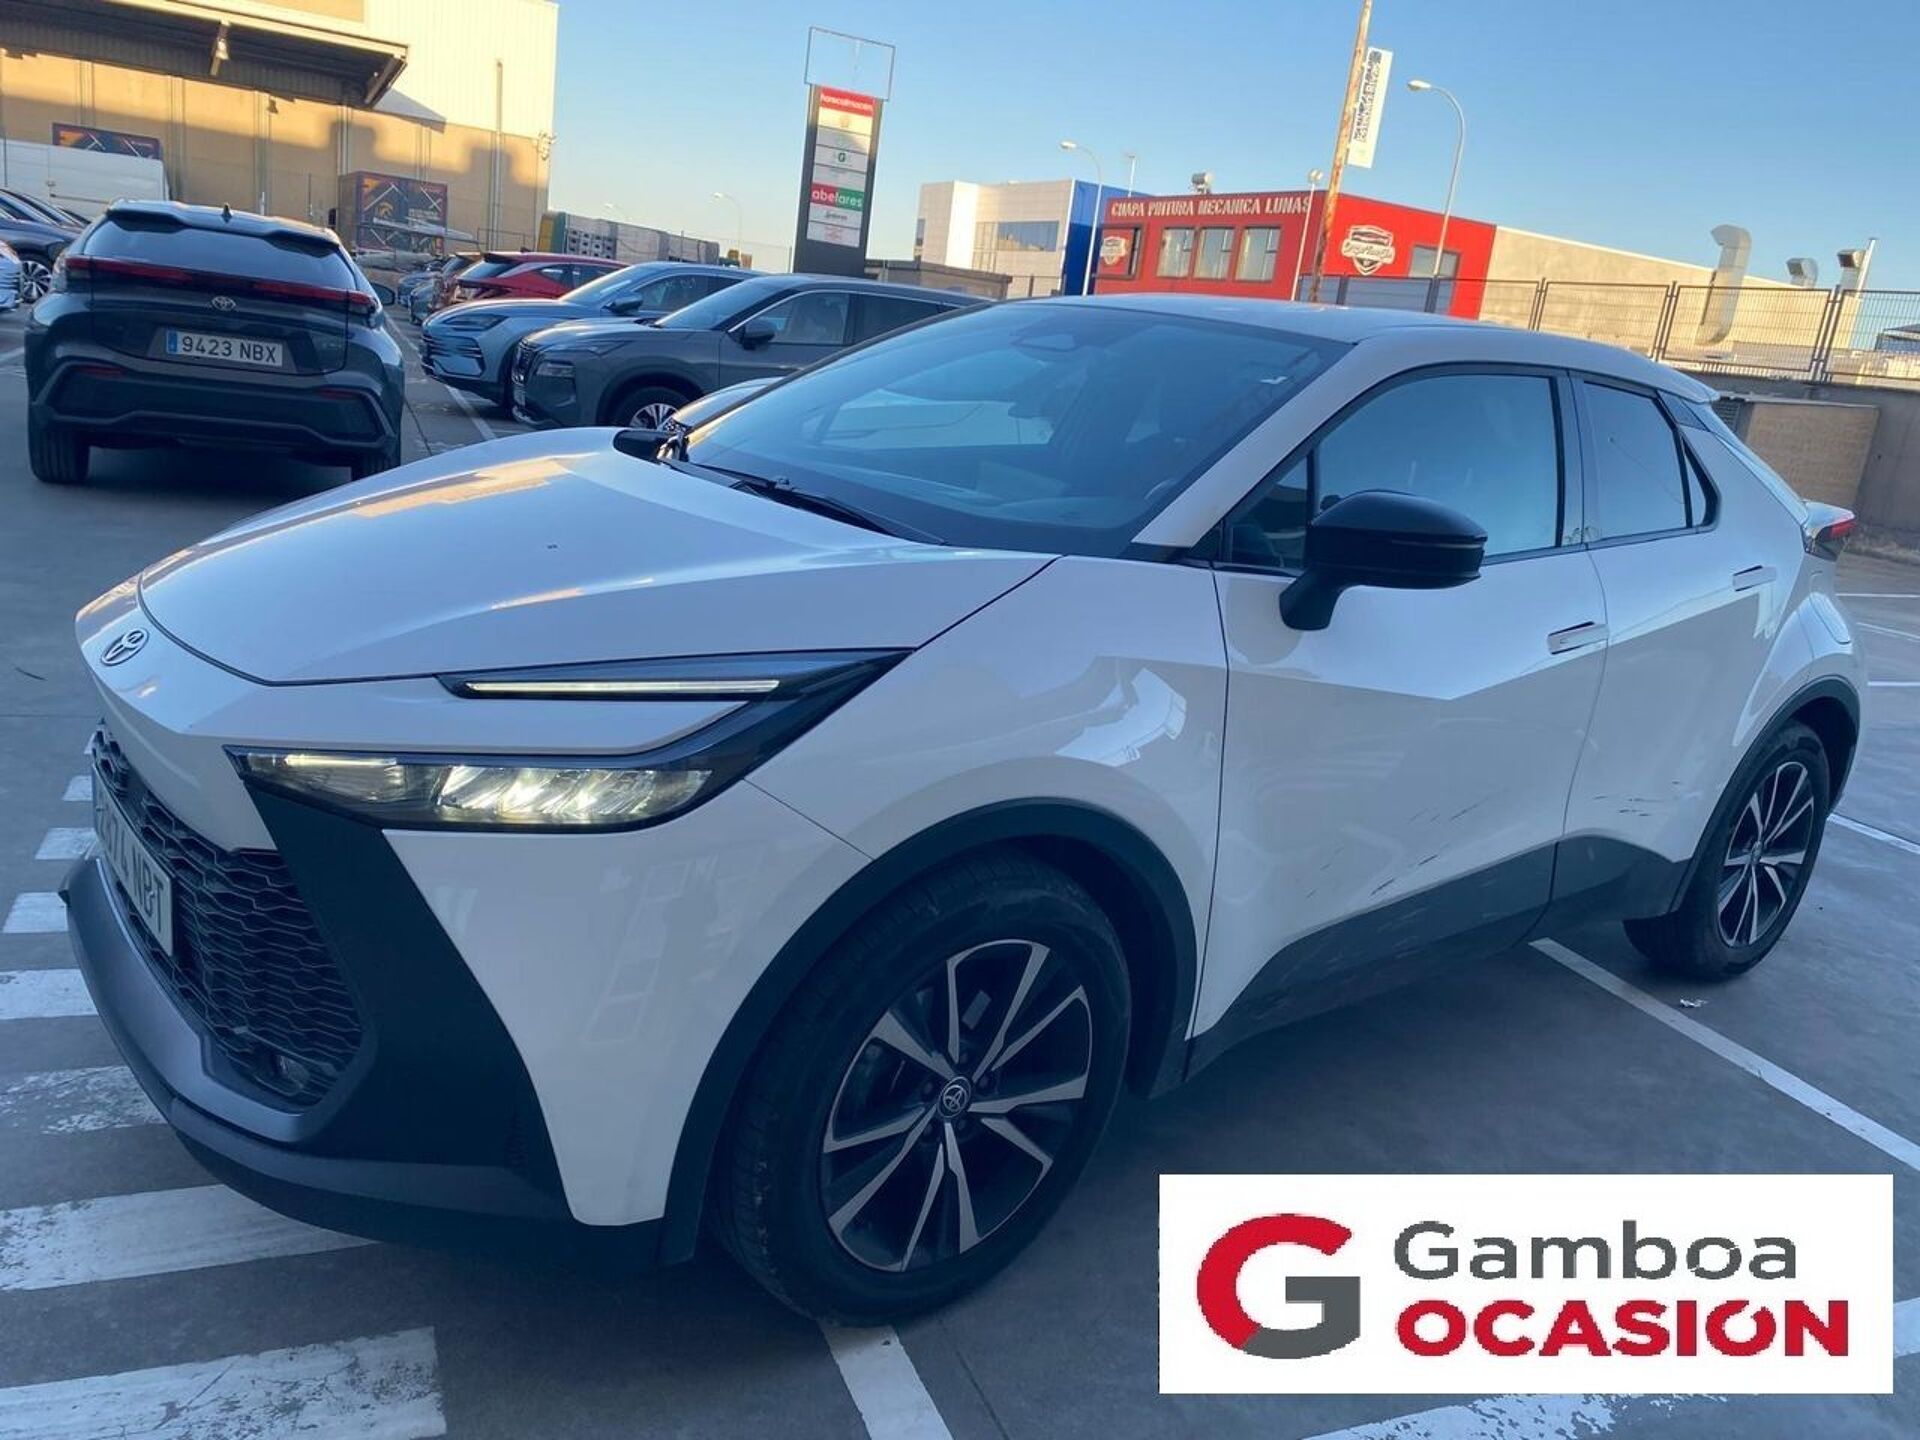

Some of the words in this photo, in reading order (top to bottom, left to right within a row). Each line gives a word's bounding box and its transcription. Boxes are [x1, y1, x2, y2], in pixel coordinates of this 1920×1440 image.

[1111, 201, 1145, 217] CHAPA
[1197, 197, 1261, 215] MECANICA
[1264, 195, 1312, 214] LUNAS
[182, 335, 232, 357] 9423
[240, 342, 276, 363] NBX
